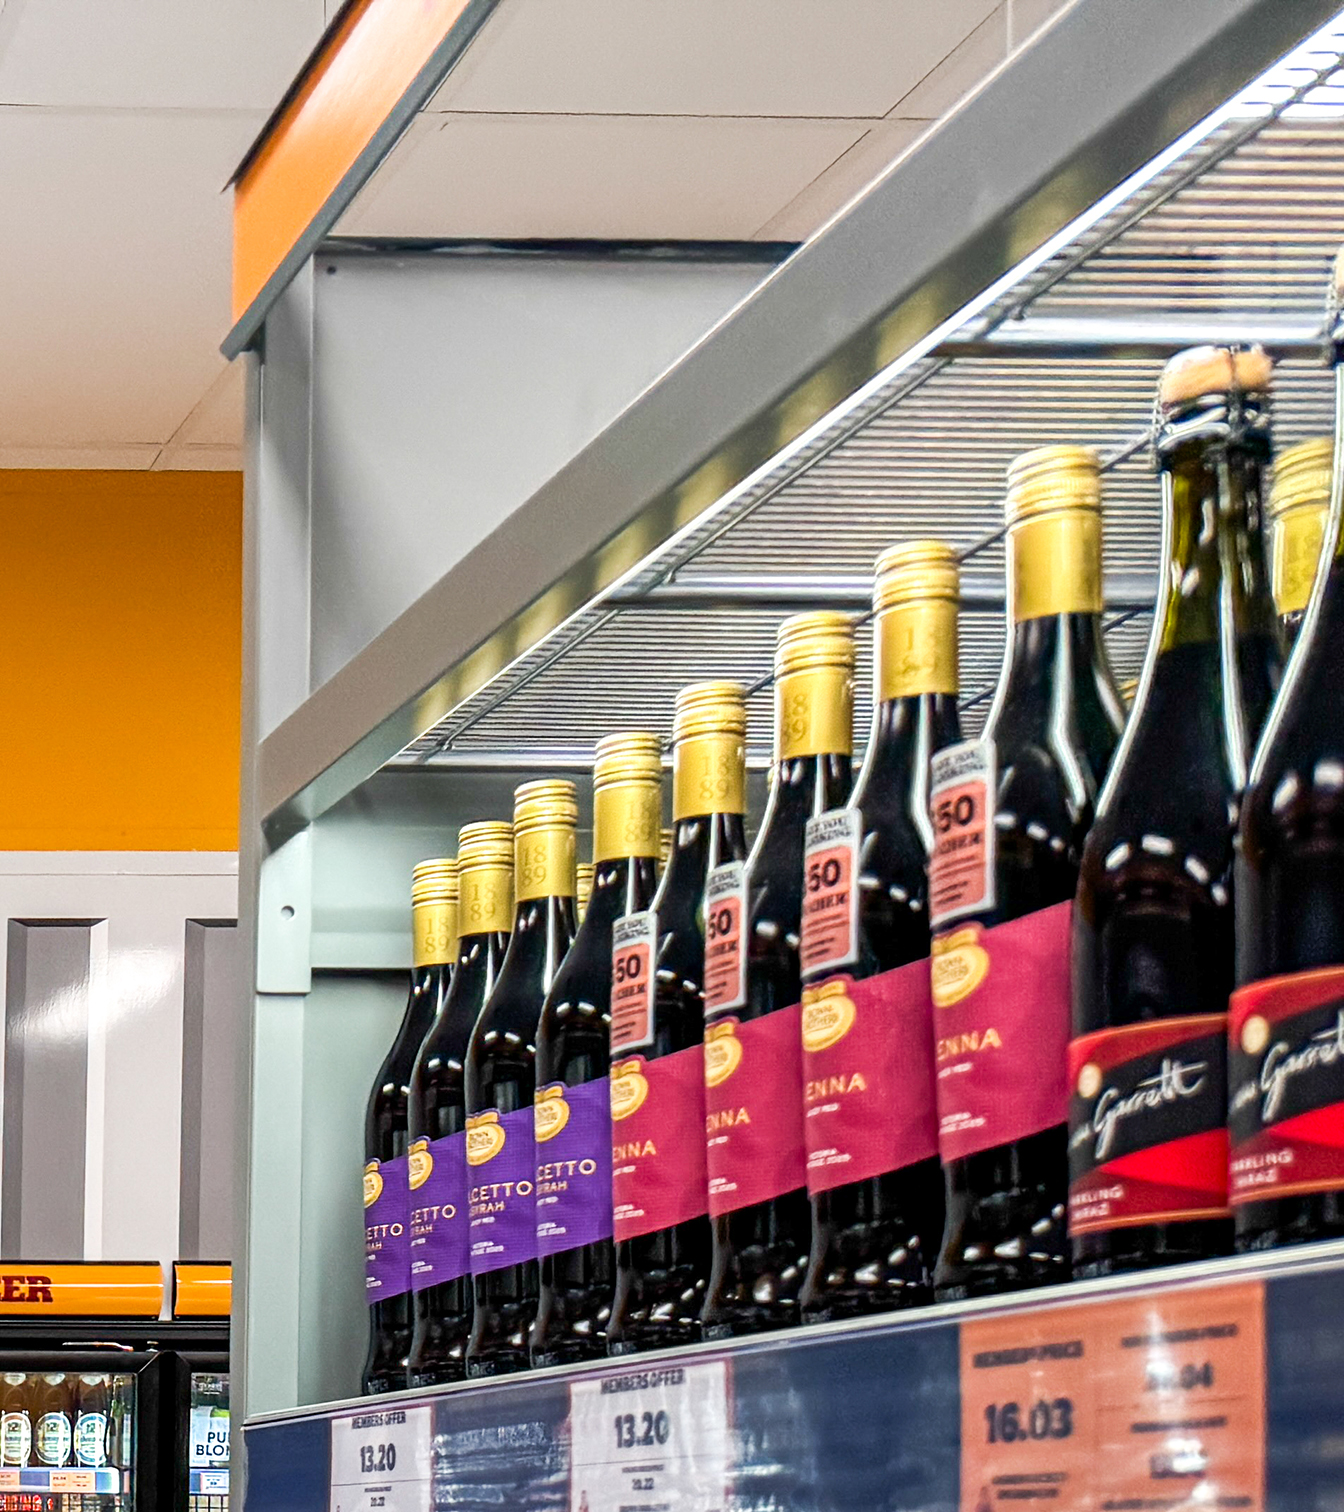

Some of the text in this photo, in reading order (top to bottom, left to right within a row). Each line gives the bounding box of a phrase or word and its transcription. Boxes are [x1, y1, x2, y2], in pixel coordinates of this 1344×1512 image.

[615, 1410, 669, 1448] 13.20
[985, 1397, 1074, 1444] 16.03
[360, 1443, 396, 1473] 13.20
